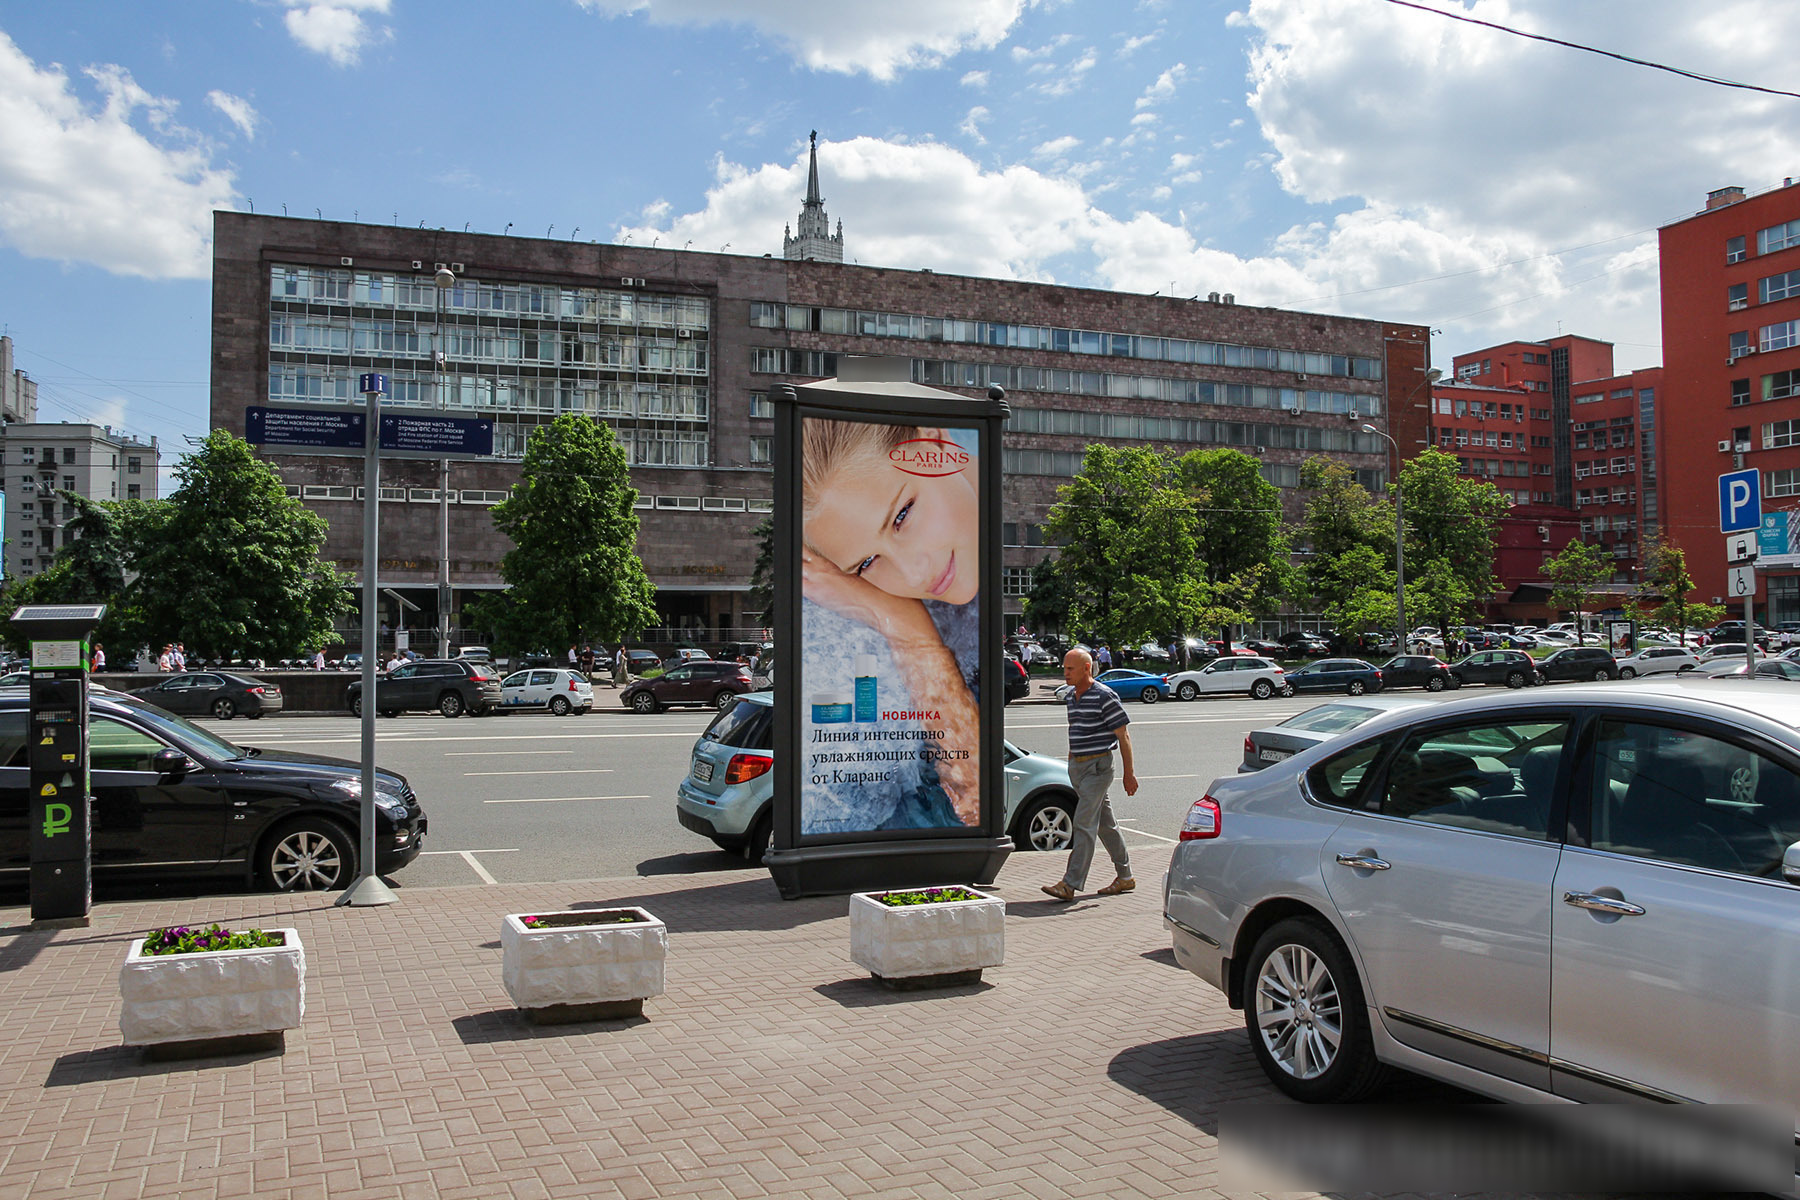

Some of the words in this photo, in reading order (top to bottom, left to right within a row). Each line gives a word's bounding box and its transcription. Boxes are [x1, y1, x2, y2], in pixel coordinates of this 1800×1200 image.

[265, 412, 305, 420] Департамент
[402, 419, 431, 427] Пожарная
[888, 449, 970, 464] CLARINS
[1729, 479, 1751, 524] P
[882, 710, 941, 721] НОВИНКА
[812, 730, 860, 743] Линия
[863, 729, 945, 742] интенсивно
[812, 750, 916, 768] увлажняющих
[919, 749, 970, 764] средств
[812, 774, 829, 785] от
[833, 769, 891, 786] Кларанс
